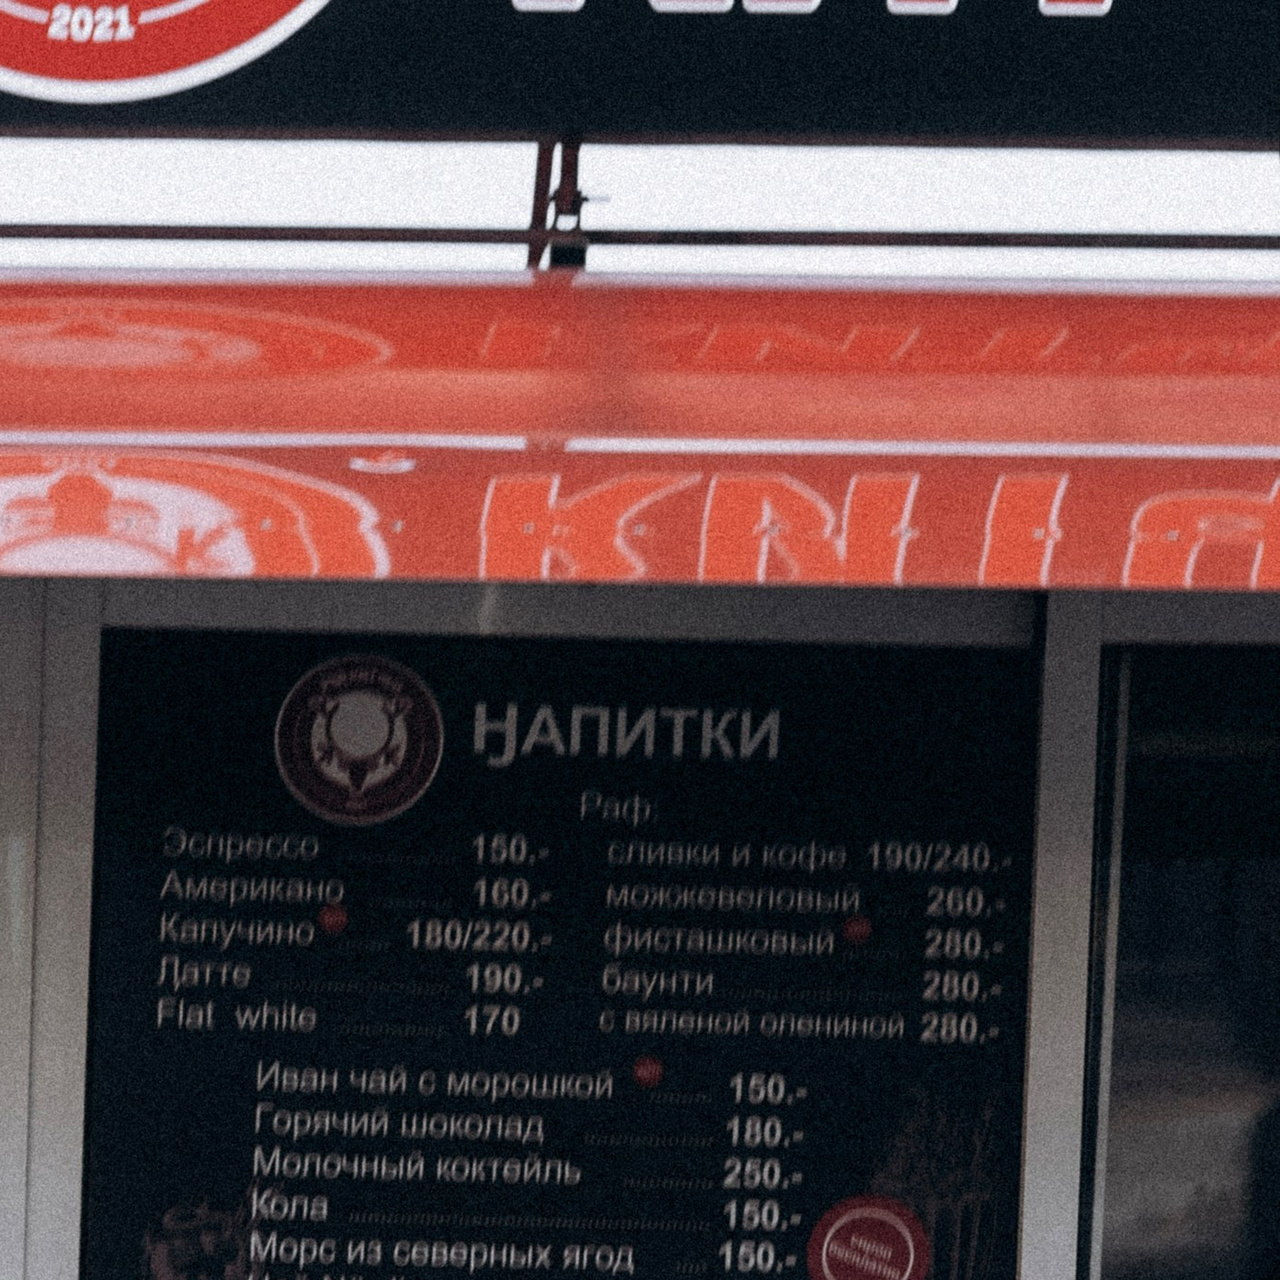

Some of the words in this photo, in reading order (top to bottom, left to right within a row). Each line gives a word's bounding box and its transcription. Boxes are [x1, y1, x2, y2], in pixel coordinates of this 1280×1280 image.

[46, 4, 135, 42] 2021
[472, 700, 782, 768] НАПИТКИ
[161, 824, 320, 865] Эспрессо
[606, 840, 721, 868] сливки
[730, 841, 751, 868] и
[761, 838, 848, 875] кофе
[159, 868, 347, 909] Американо
[604, 881, 863, 914] можжевеловый
[158, 910, 317, 951] Капучино
[602, 919, 837, 958] фисташковый
[156, 954, 253, 994] Латте
[600, 960, 716, 1002] баунти
[156, 996, 216, 1031] Flat
[234, 999, 319, 1035] white
[463, 1002, 521, 1037] 170
[597, 1008, 616, 1034] с
[624, 1005, 752, 1037] вяленой
[758, 1008, 907, 1040] олениной
[255, 1060, 340, 1094] Иван
[348, 1063, 409, 1095] чай
[417, 1069, 437, 1095] с
[445, 1066, 614, 1106] морошкой
[253, 1100, 391, 1143] Горячий
[399, 1111, 546, 1145] шоколад
[251, 1144, 427, 1182] Молочный
[435, 1152, 583, 1187] коктейль
[250, 1187, 331, 1223] Кола
[247, 1229, 338, 1271] Морс
[345, 1237, 384, 1267] из
[392, 1238, 553, 1276] северных
[561, 1243, 637, 1277] ягод
